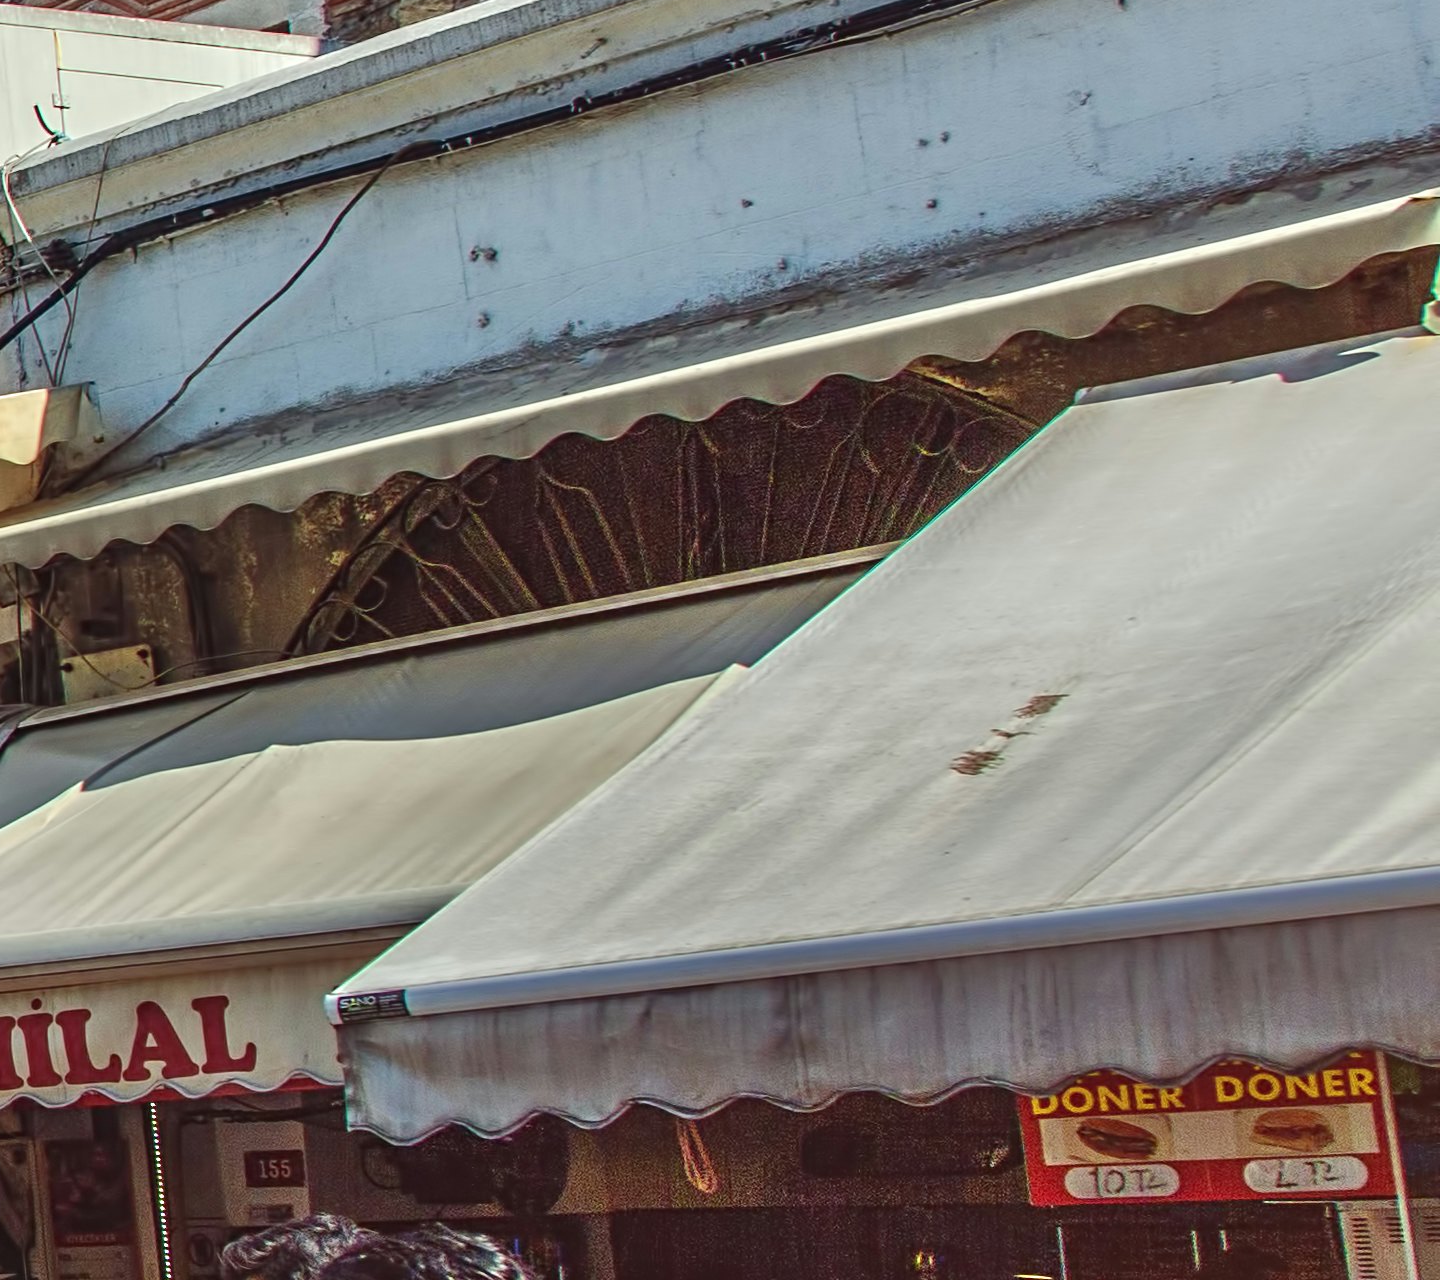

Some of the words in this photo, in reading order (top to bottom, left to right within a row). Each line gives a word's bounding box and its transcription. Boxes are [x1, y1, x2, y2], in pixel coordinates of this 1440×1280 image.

[1215, 1064, 1377, 1104] DÖNER
[258, 1159, 291, 1179] 155
[1089, 1166, 1126, 1198] 10
